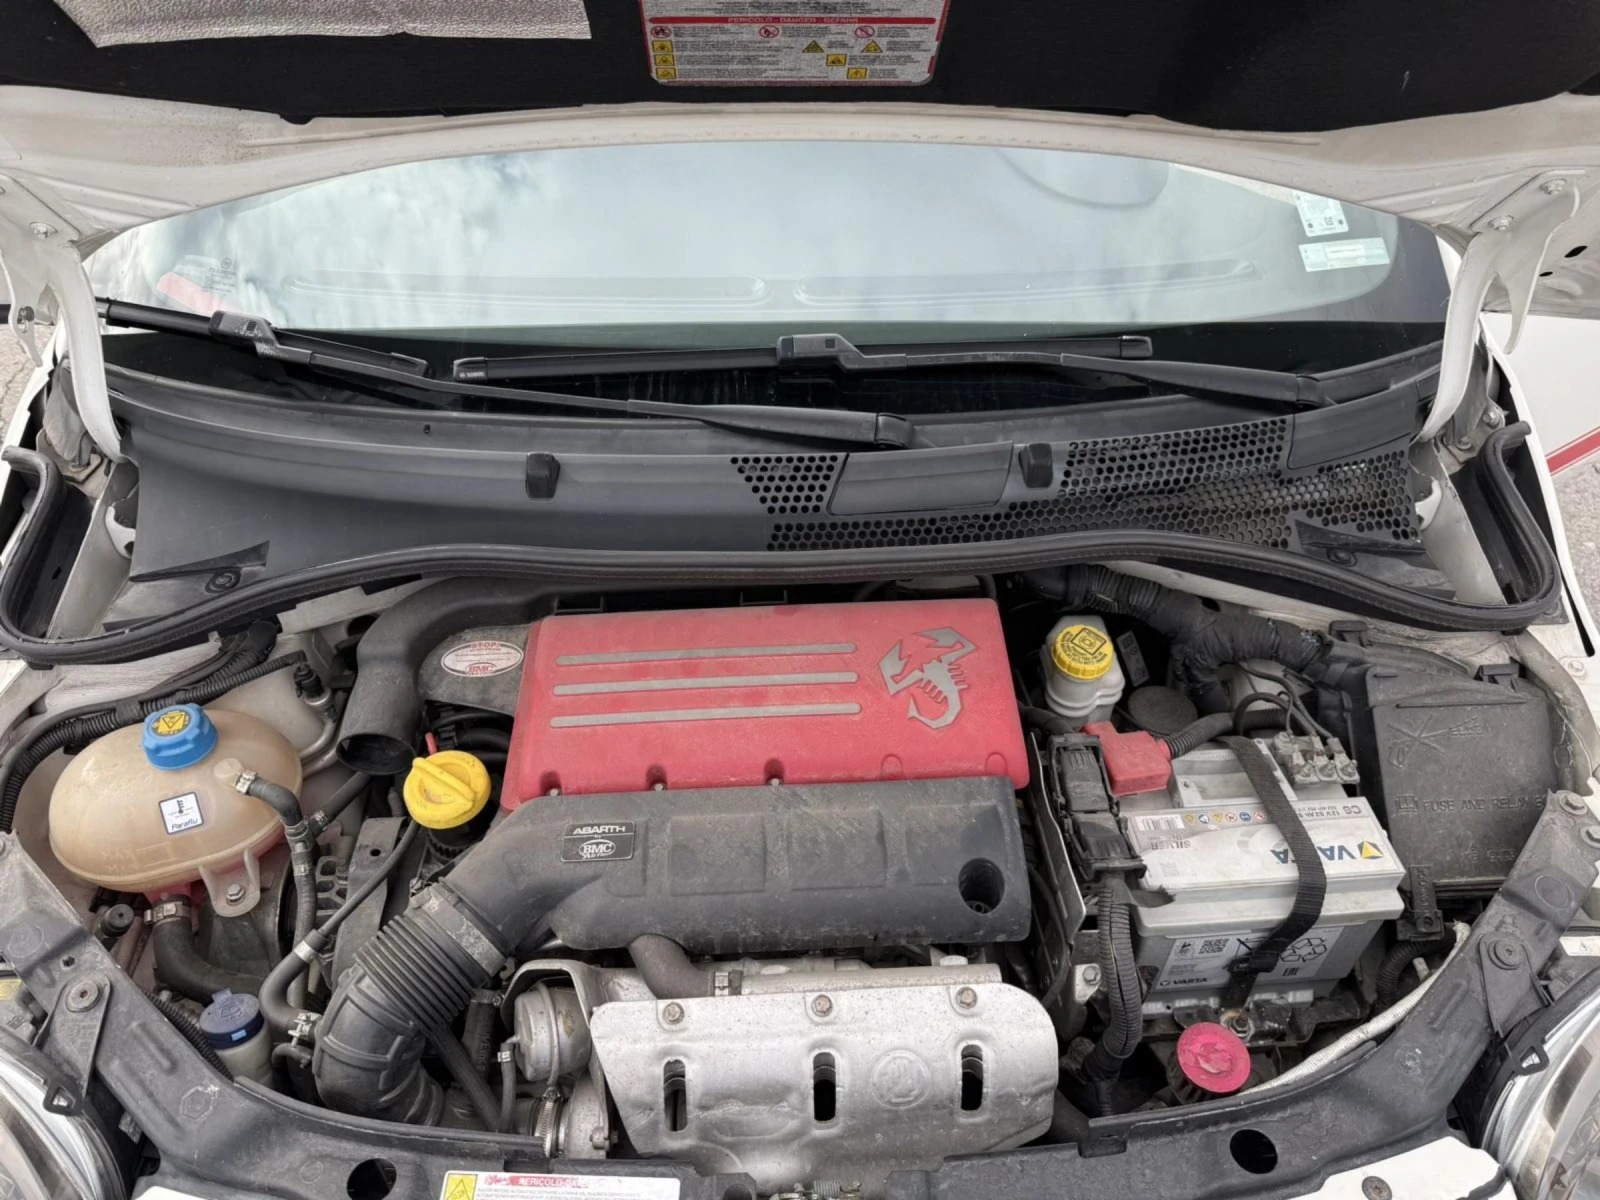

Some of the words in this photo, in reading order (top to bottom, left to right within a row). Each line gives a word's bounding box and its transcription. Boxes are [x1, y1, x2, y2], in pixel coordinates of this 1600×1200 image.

[1423, 800, 1455, 811] FUSE
[171, 818, 198, 830] Paraflu
[573, 825, 626, 835] ABARTH
[583, 844, 612, 853] BMC
[1151, 840, 1191, 850] SILVER
[1173, 977, 1208, 985] VARTA
